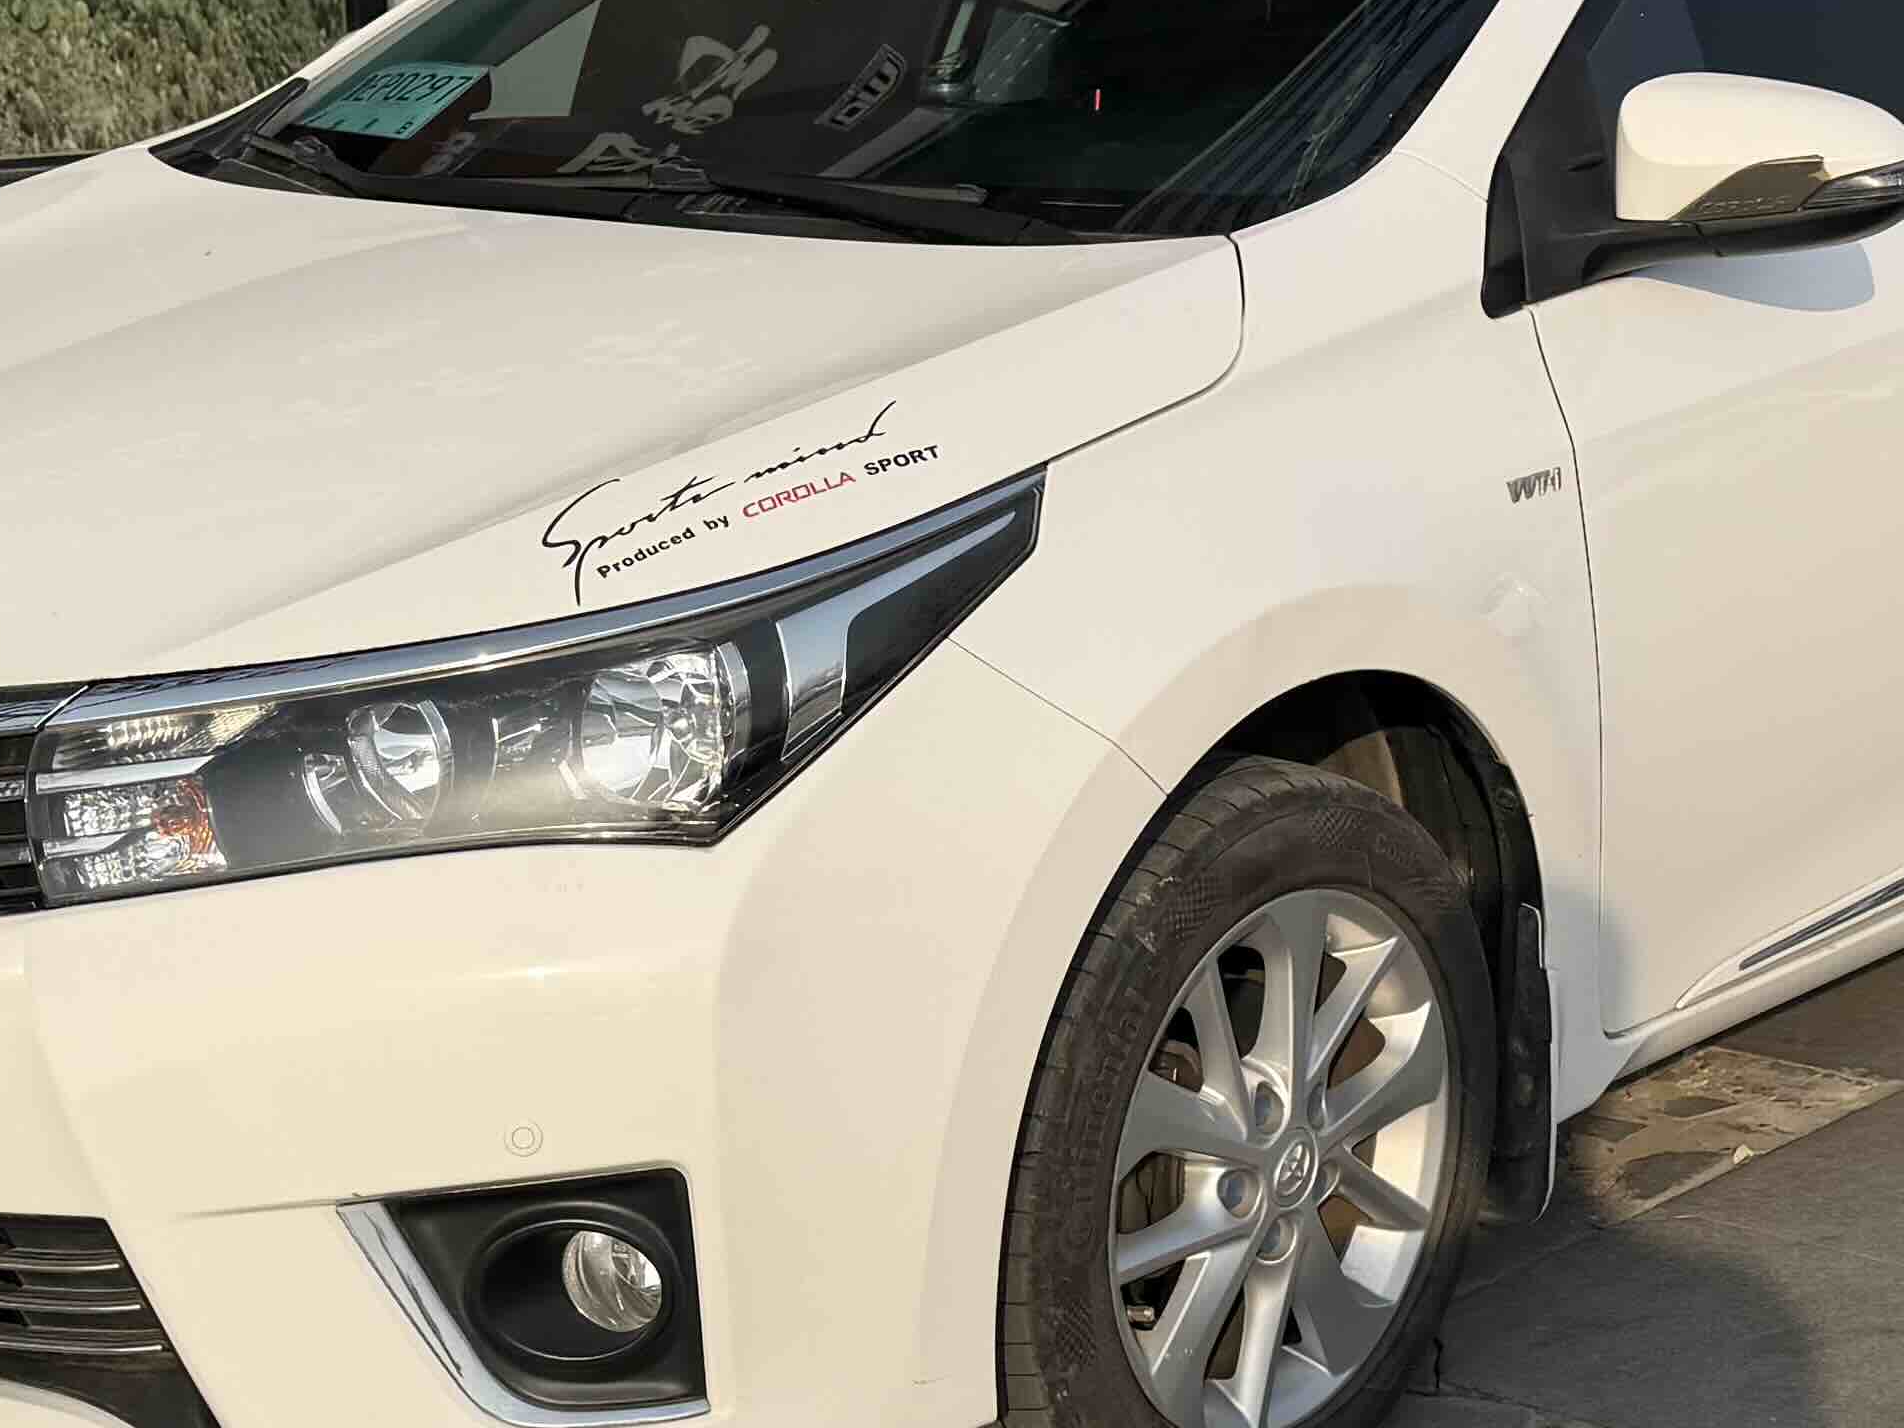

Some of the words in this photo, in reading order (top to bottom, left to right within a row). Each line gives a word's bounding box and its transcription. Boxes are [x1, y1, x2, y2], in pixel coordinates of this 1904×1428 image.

[597, 525, 696, 579] Produced
[703, 514, 730, 532] by
[742, 471, 856, 519] COROLLA
[863, 445, 940, 476] SPORT
